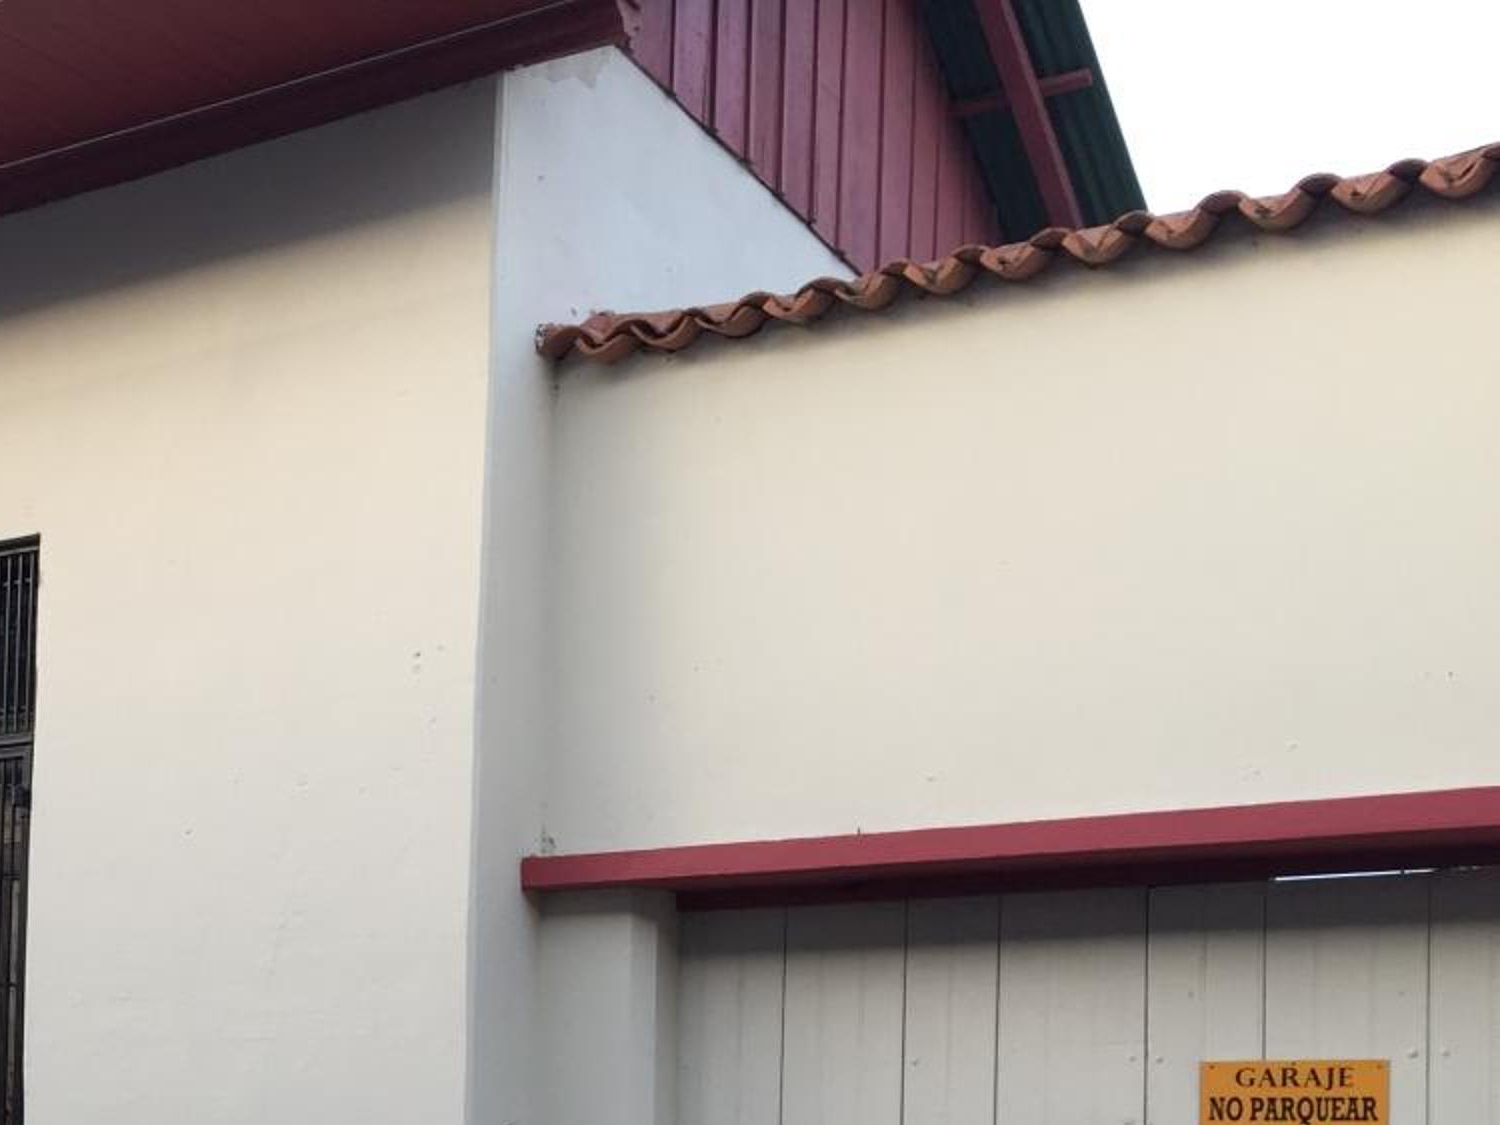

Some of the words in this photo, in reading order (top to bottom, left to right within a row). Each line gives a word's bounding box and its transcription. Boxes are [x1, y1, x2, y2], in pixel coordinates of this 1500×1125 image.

[1235, 1066, 1354, 1090] GARAJE
[1209, 1097, 1243, 1121] NO
[1250, 1097, 1378, 1125] PARQUEAR
